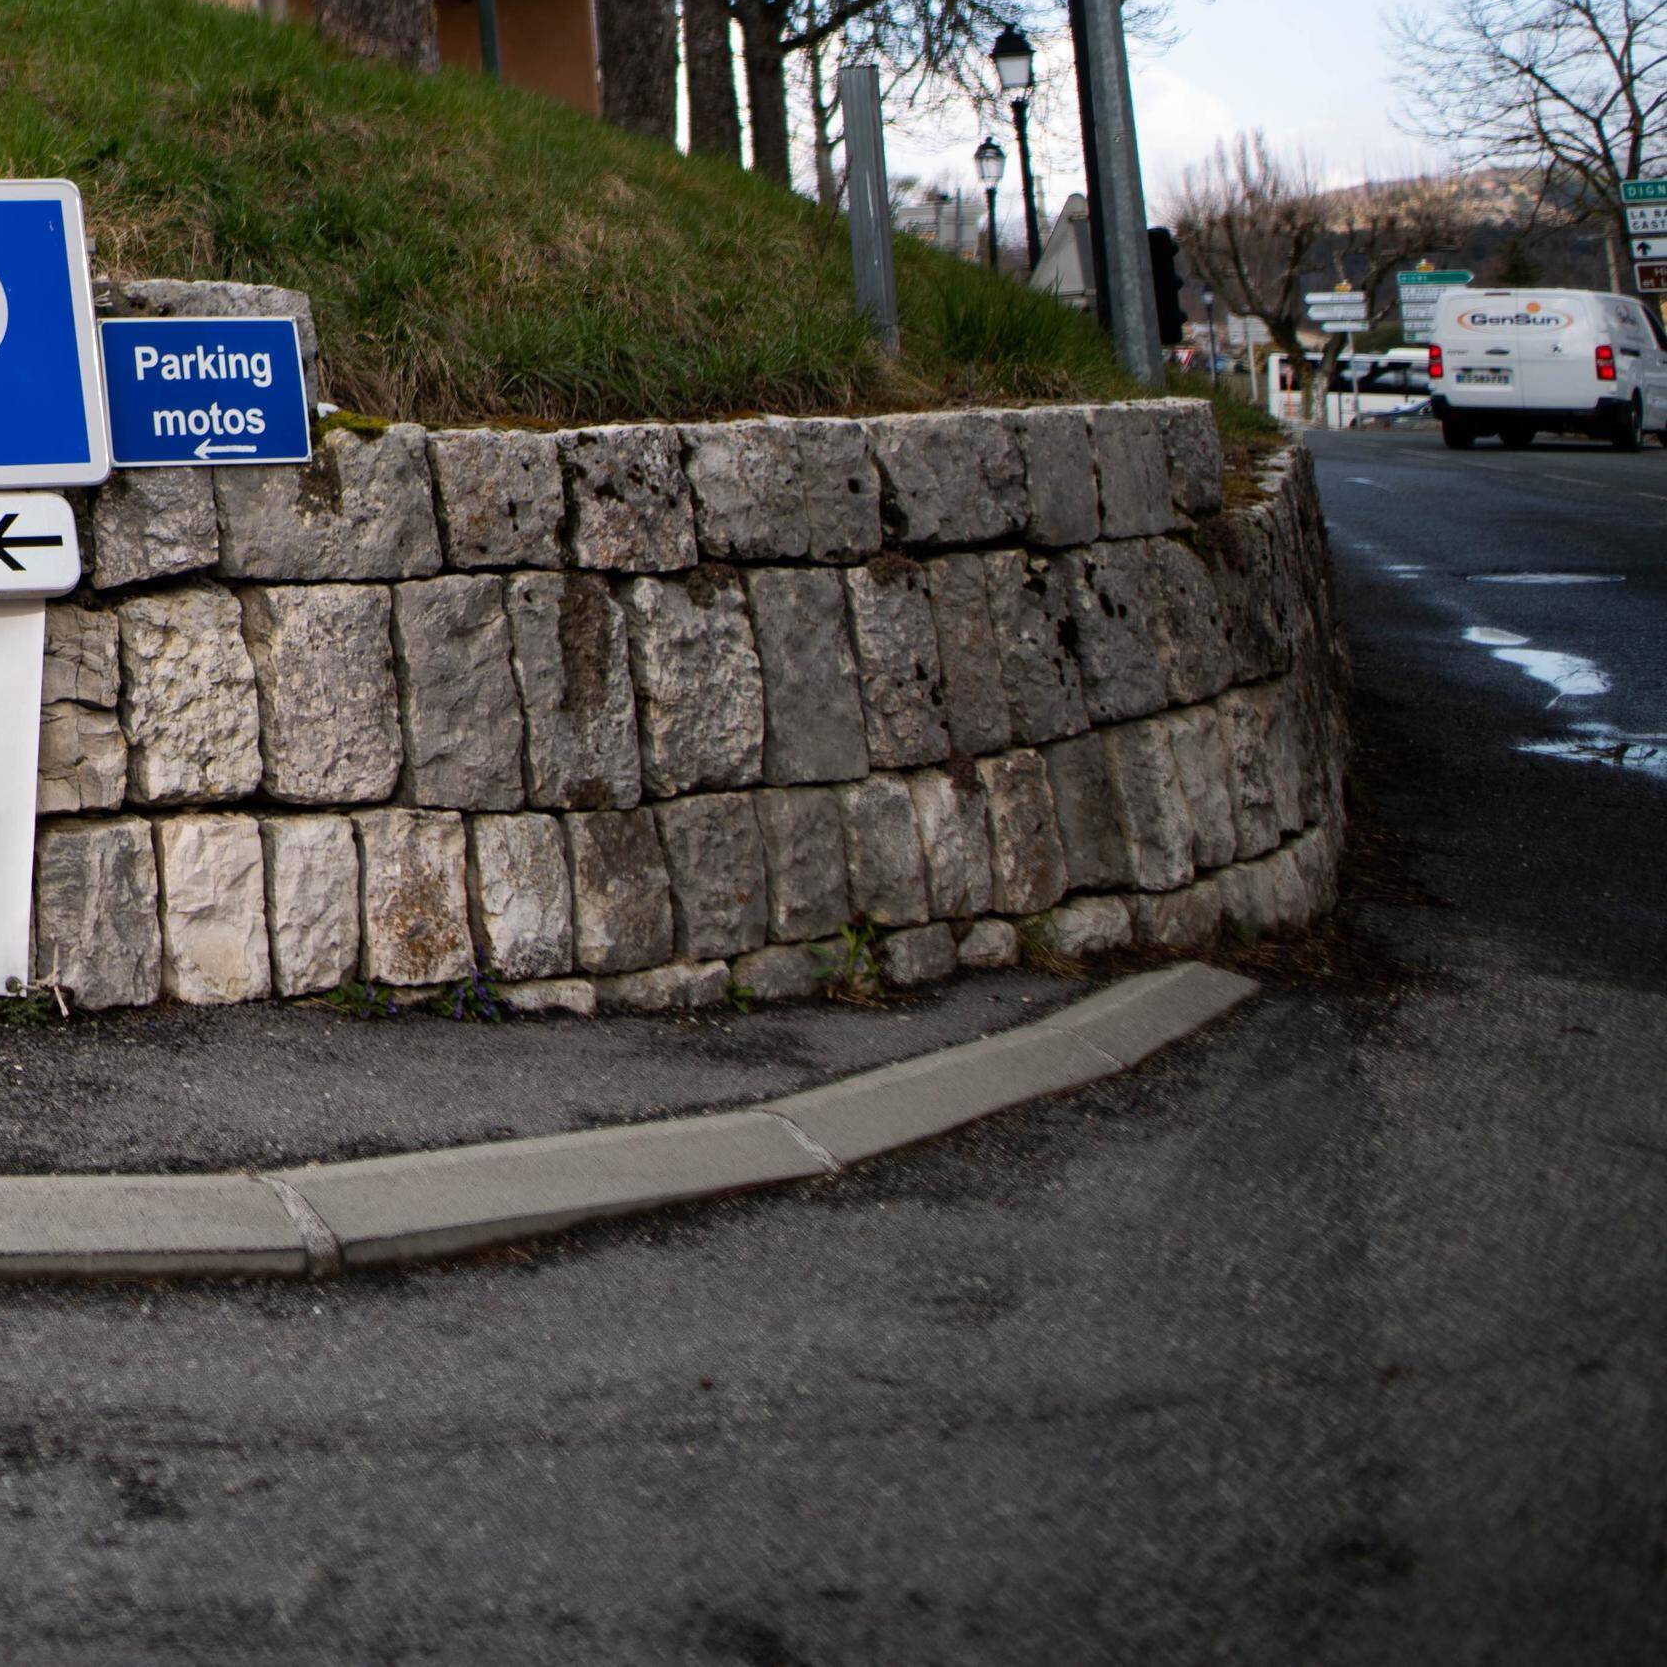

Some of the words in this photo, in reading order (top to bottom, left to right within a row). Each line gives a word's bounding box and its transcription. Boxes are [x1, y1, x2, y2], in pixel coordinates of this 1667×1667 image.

[1470, 313, 1560, 326] GenSun
[135, 345, 272, 387] Parking
[154, 403, 265, 435] motos
